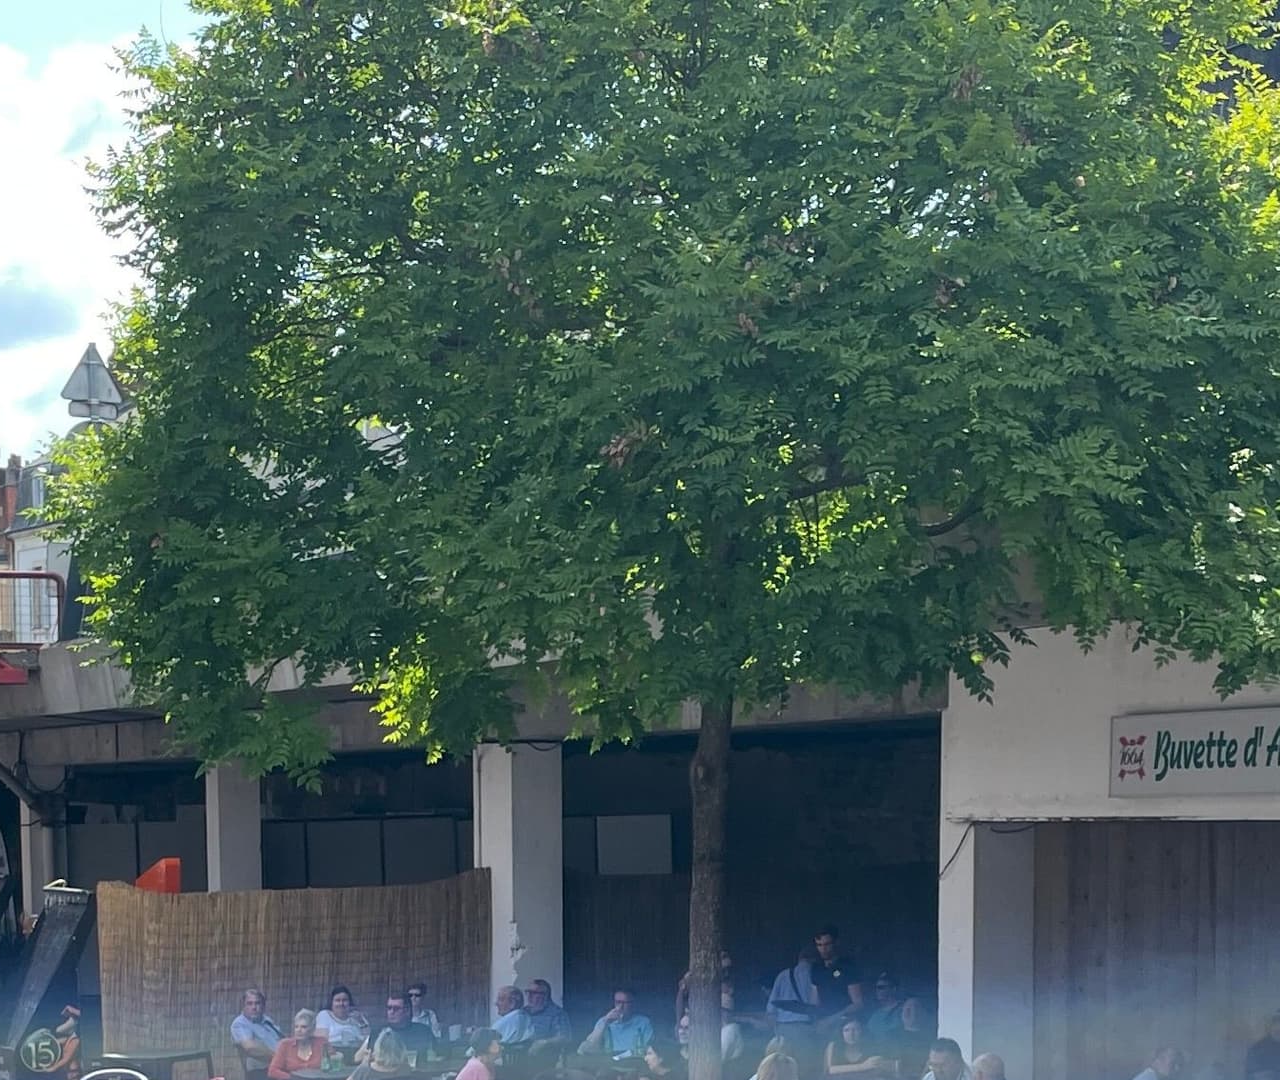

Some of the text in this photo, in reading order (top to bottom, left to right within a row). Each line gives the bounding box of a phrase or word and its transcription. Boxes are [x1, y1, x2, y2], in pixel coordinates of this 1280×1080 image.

[1119, 746, 1146, 766] 1664
[1154, 730, 1238, 782] Buvette
[27, 1041, 56, 1070] 15
